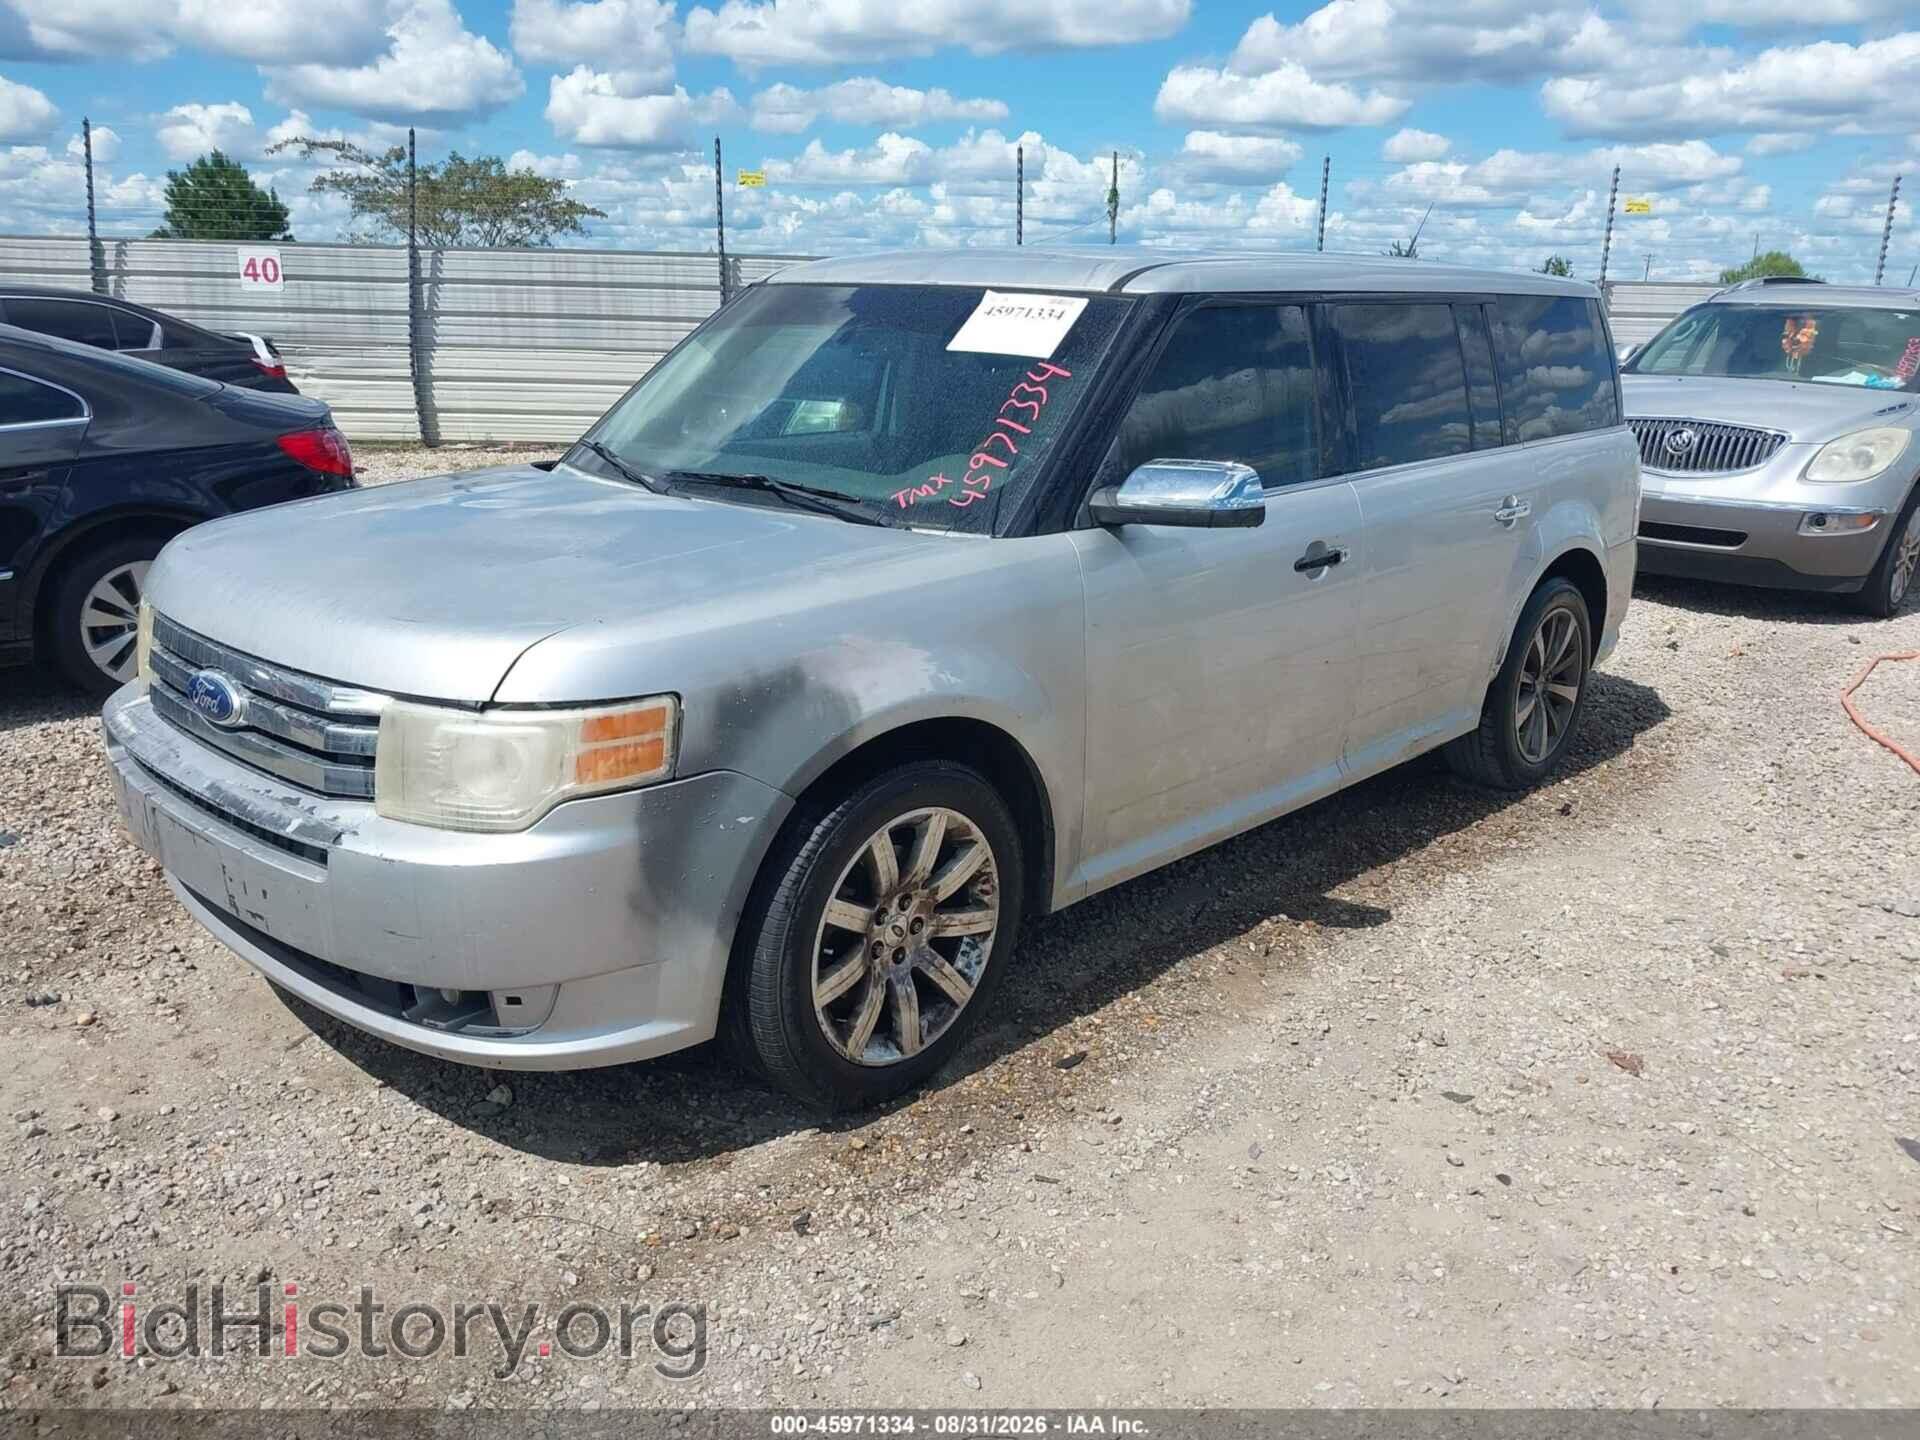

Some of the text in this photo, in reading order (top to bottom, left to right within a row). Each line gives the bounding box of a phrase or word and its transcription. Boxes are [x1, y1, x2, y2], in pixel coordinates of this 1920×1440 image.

[243, 257, 280, 283] 40
[984, 305, 1066, 321] 45971334
[949, 361, 1072, 507] 45971334
[192, 677, 224, 713] Ford
